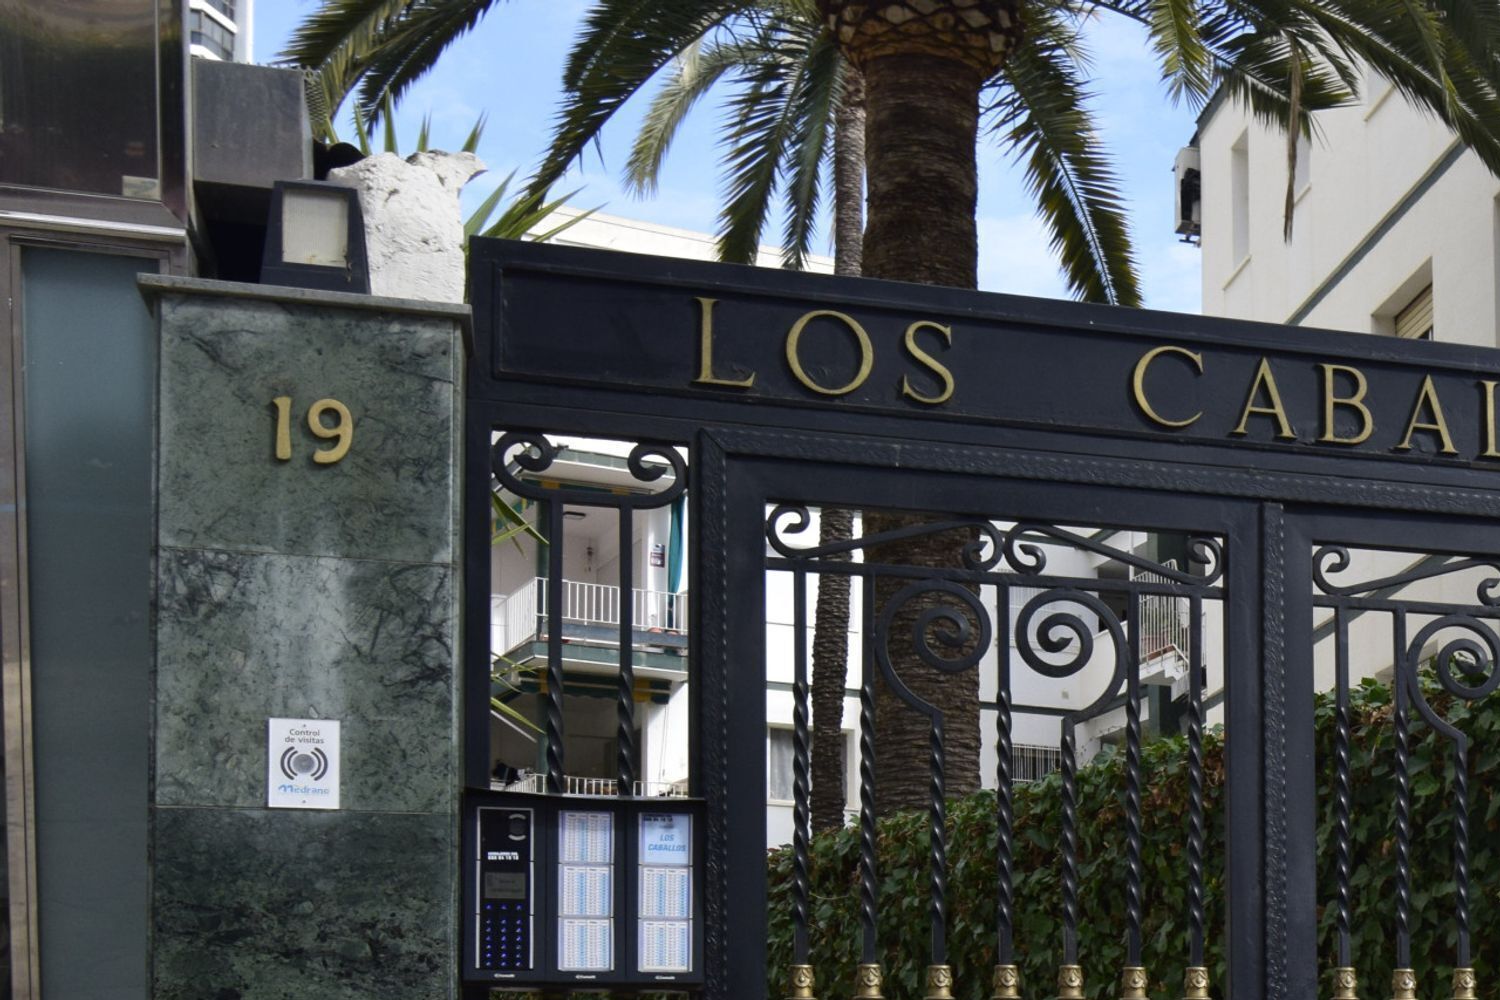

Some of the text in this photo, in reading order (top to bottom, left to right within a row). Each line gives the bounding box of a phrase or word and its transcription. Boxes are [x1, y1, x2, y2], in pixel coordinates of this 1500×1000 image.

[693, 297, 955, 404] LOS
[272, 396, 353, 464] 19
[284, 736, 325, 745] de visitas
[289, 728, 320, 737] Control
